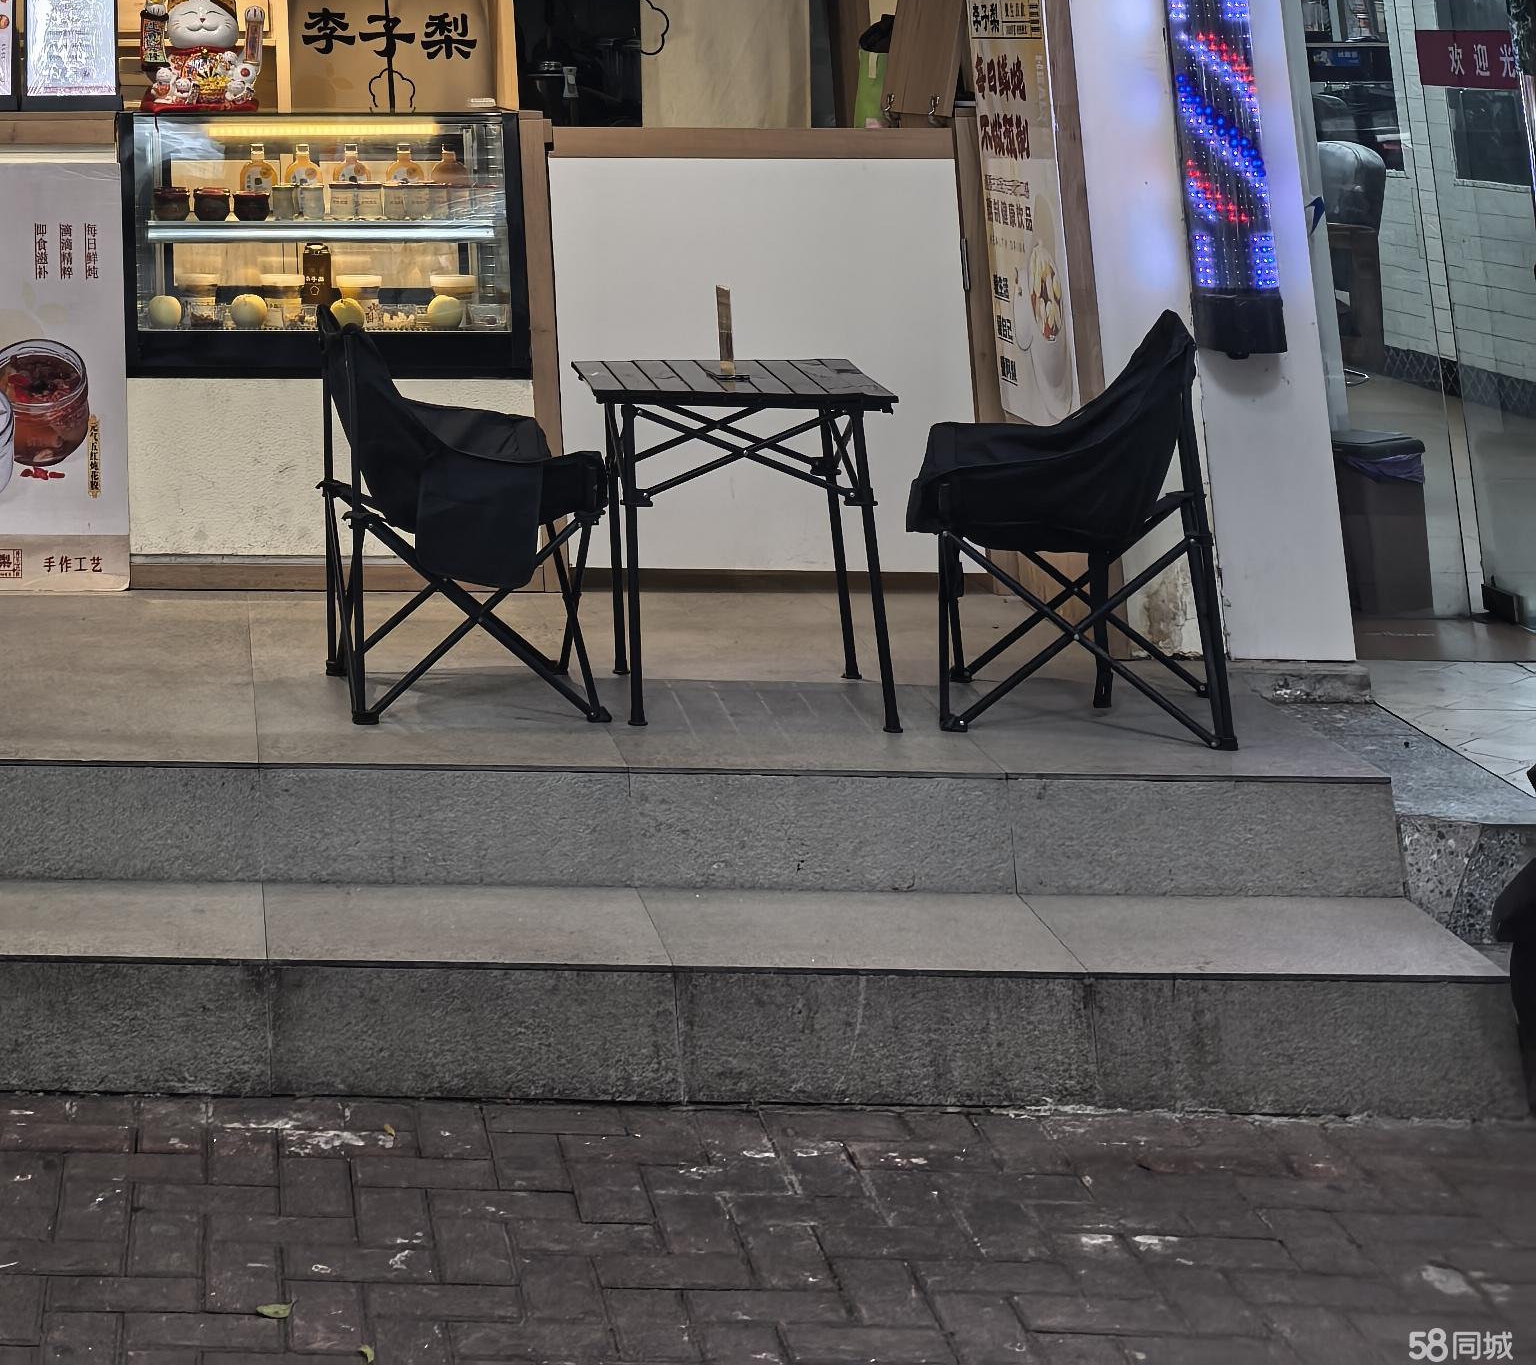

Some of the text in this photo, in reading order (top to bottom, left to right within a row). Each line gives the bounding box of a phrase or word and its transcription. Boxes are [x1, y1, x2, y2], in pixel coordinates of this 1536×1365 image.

[301, 7, 477, 61] 李子梨
[86, 223, 99, 279] 每日鲜炖
[43, 555, 103, 573] 手作工艺
